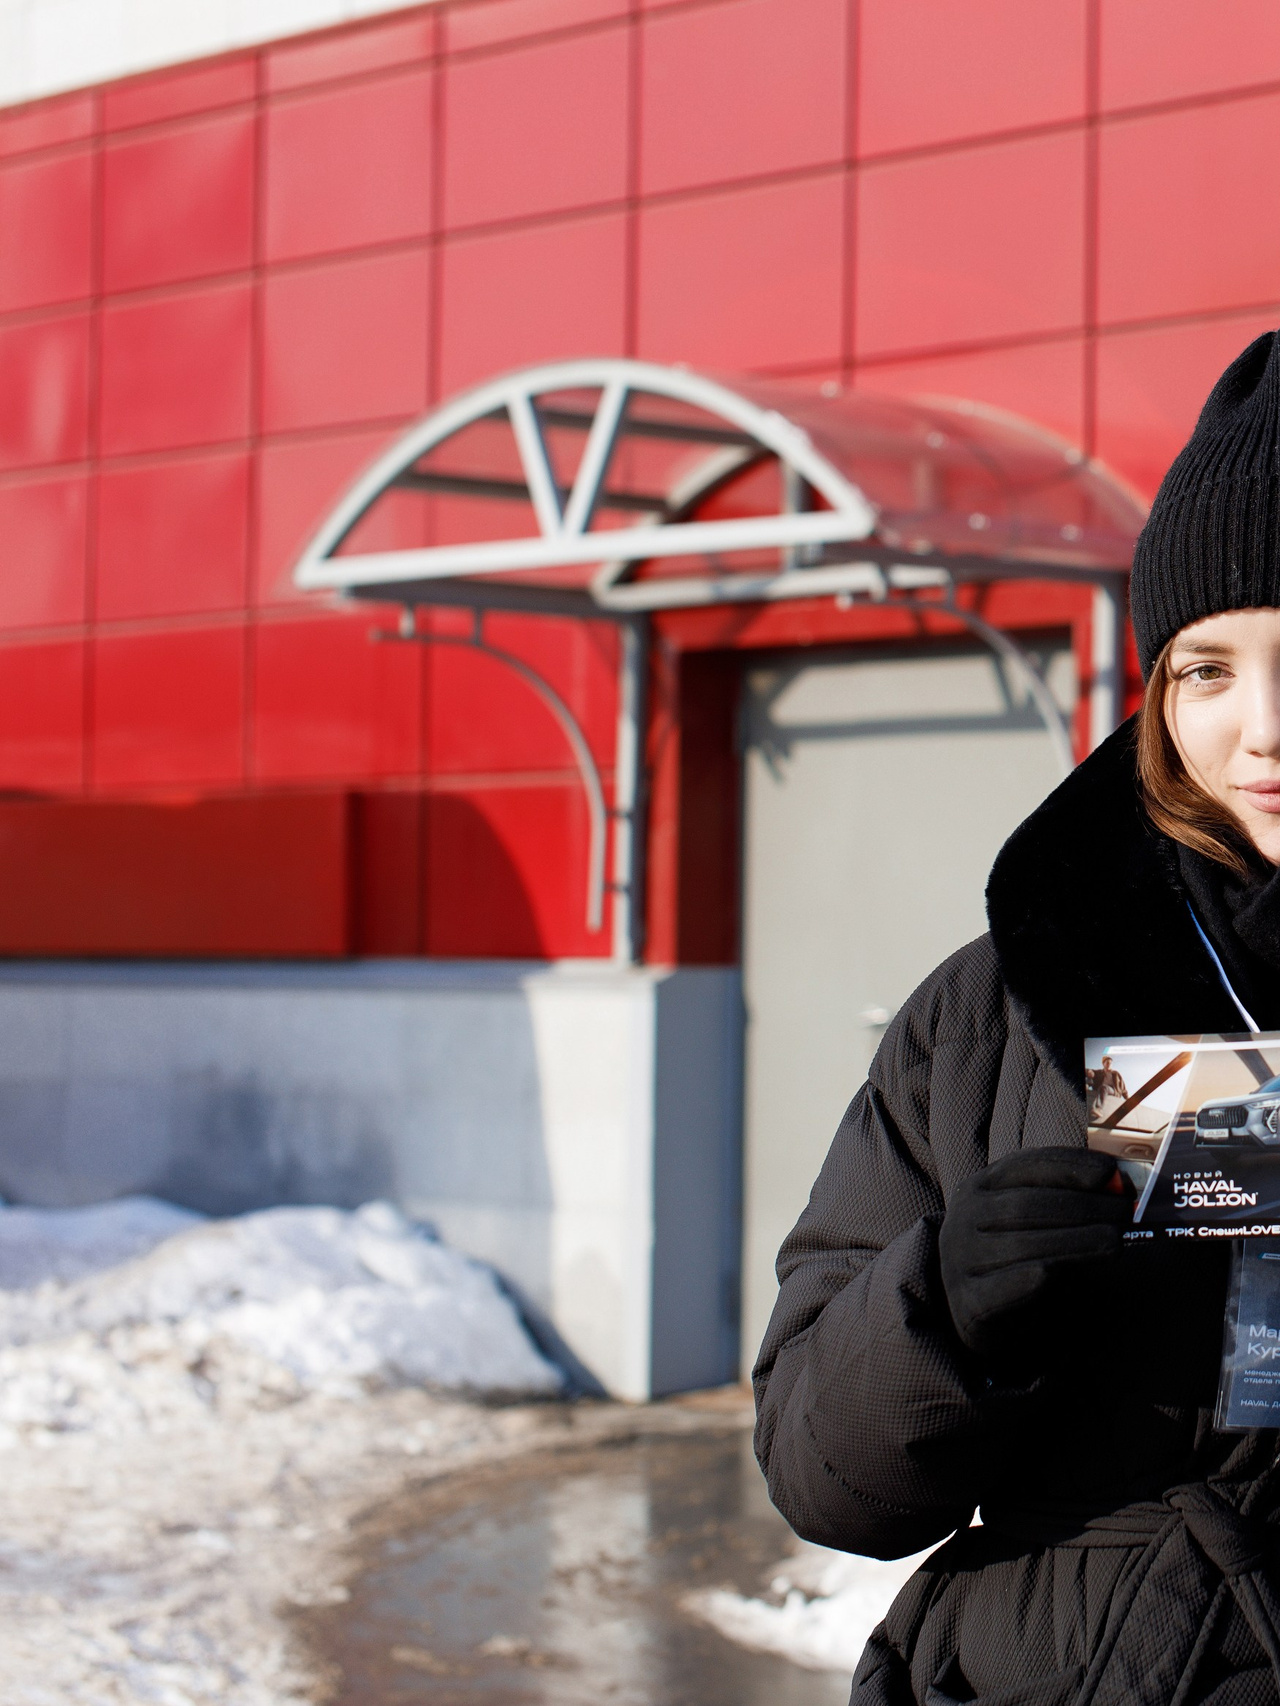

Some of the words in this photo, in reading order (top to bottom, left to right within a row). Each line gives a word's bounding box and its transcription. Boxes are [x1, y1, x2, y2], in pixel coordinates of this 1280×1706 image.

[1174, 1180, 1242, 1194] HAVAL
[1174, 1192, 1257, 1207] JOLION
[1123, 1230, 1154, 1240] арта
[1165, 1227, 1195, 1237] ТРК
[1198, 1225, 1280, 1237] СпешиLOVE
[1240, 1399, 1270, 1408] HAVAL
